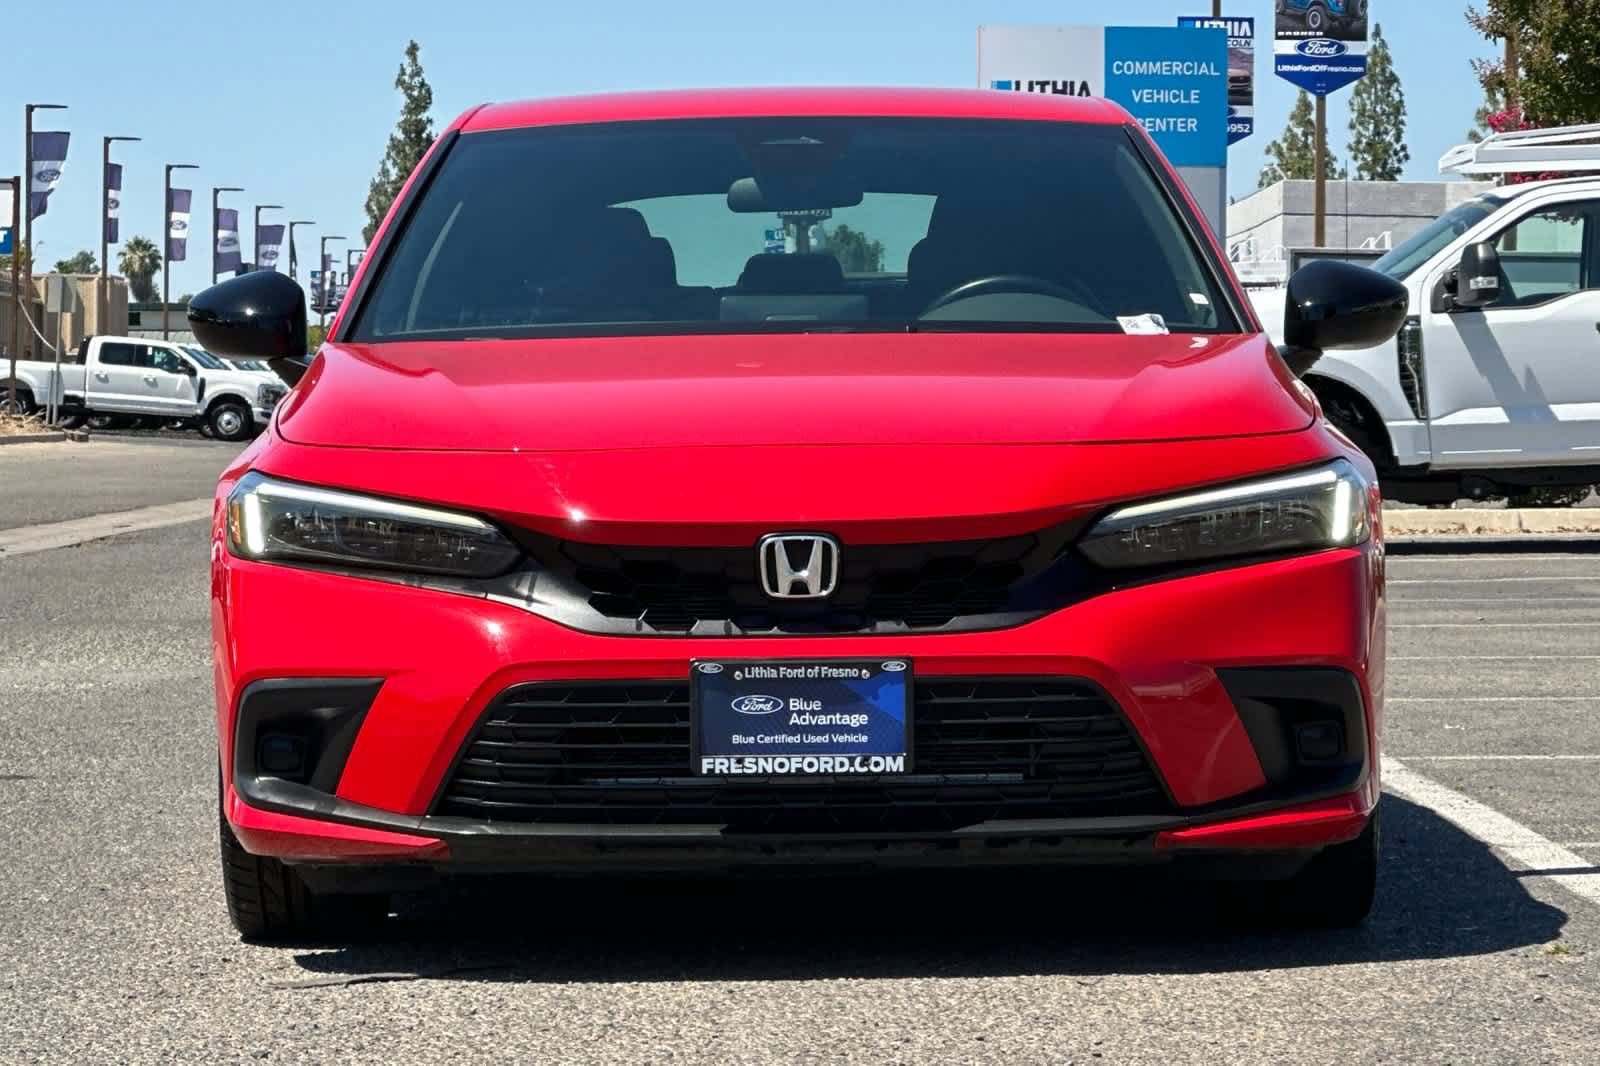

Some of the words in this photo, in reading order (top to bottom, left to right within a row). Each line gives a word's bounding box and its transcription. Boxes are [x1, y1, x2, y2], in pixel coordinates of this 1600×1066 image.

[1305, 40, 1338, 54] Ford
[1112, 60, 1220, 76] COMMERCIAL
[1131, 89, 1200, 104] VEHICLE
[744, 666, 778, 678] Lithia
[779, 666, 805, 678] Ford
[806, 666, 820, 678] of
[821, 667, 859, 678] Fresno
[741, 697, 774, 711] Ford
[789, 698, 822, 711] Blue
[789, 713, 868, 727] Advantage
[732, 734, 755, 744] Blue
[757, 734, 801, 744] Certified
[803, 733, 829, 743] Used
[831, 733, 868, 743] Vehicle
[701, 756, 905, 774] FRESNOFORD.COM
